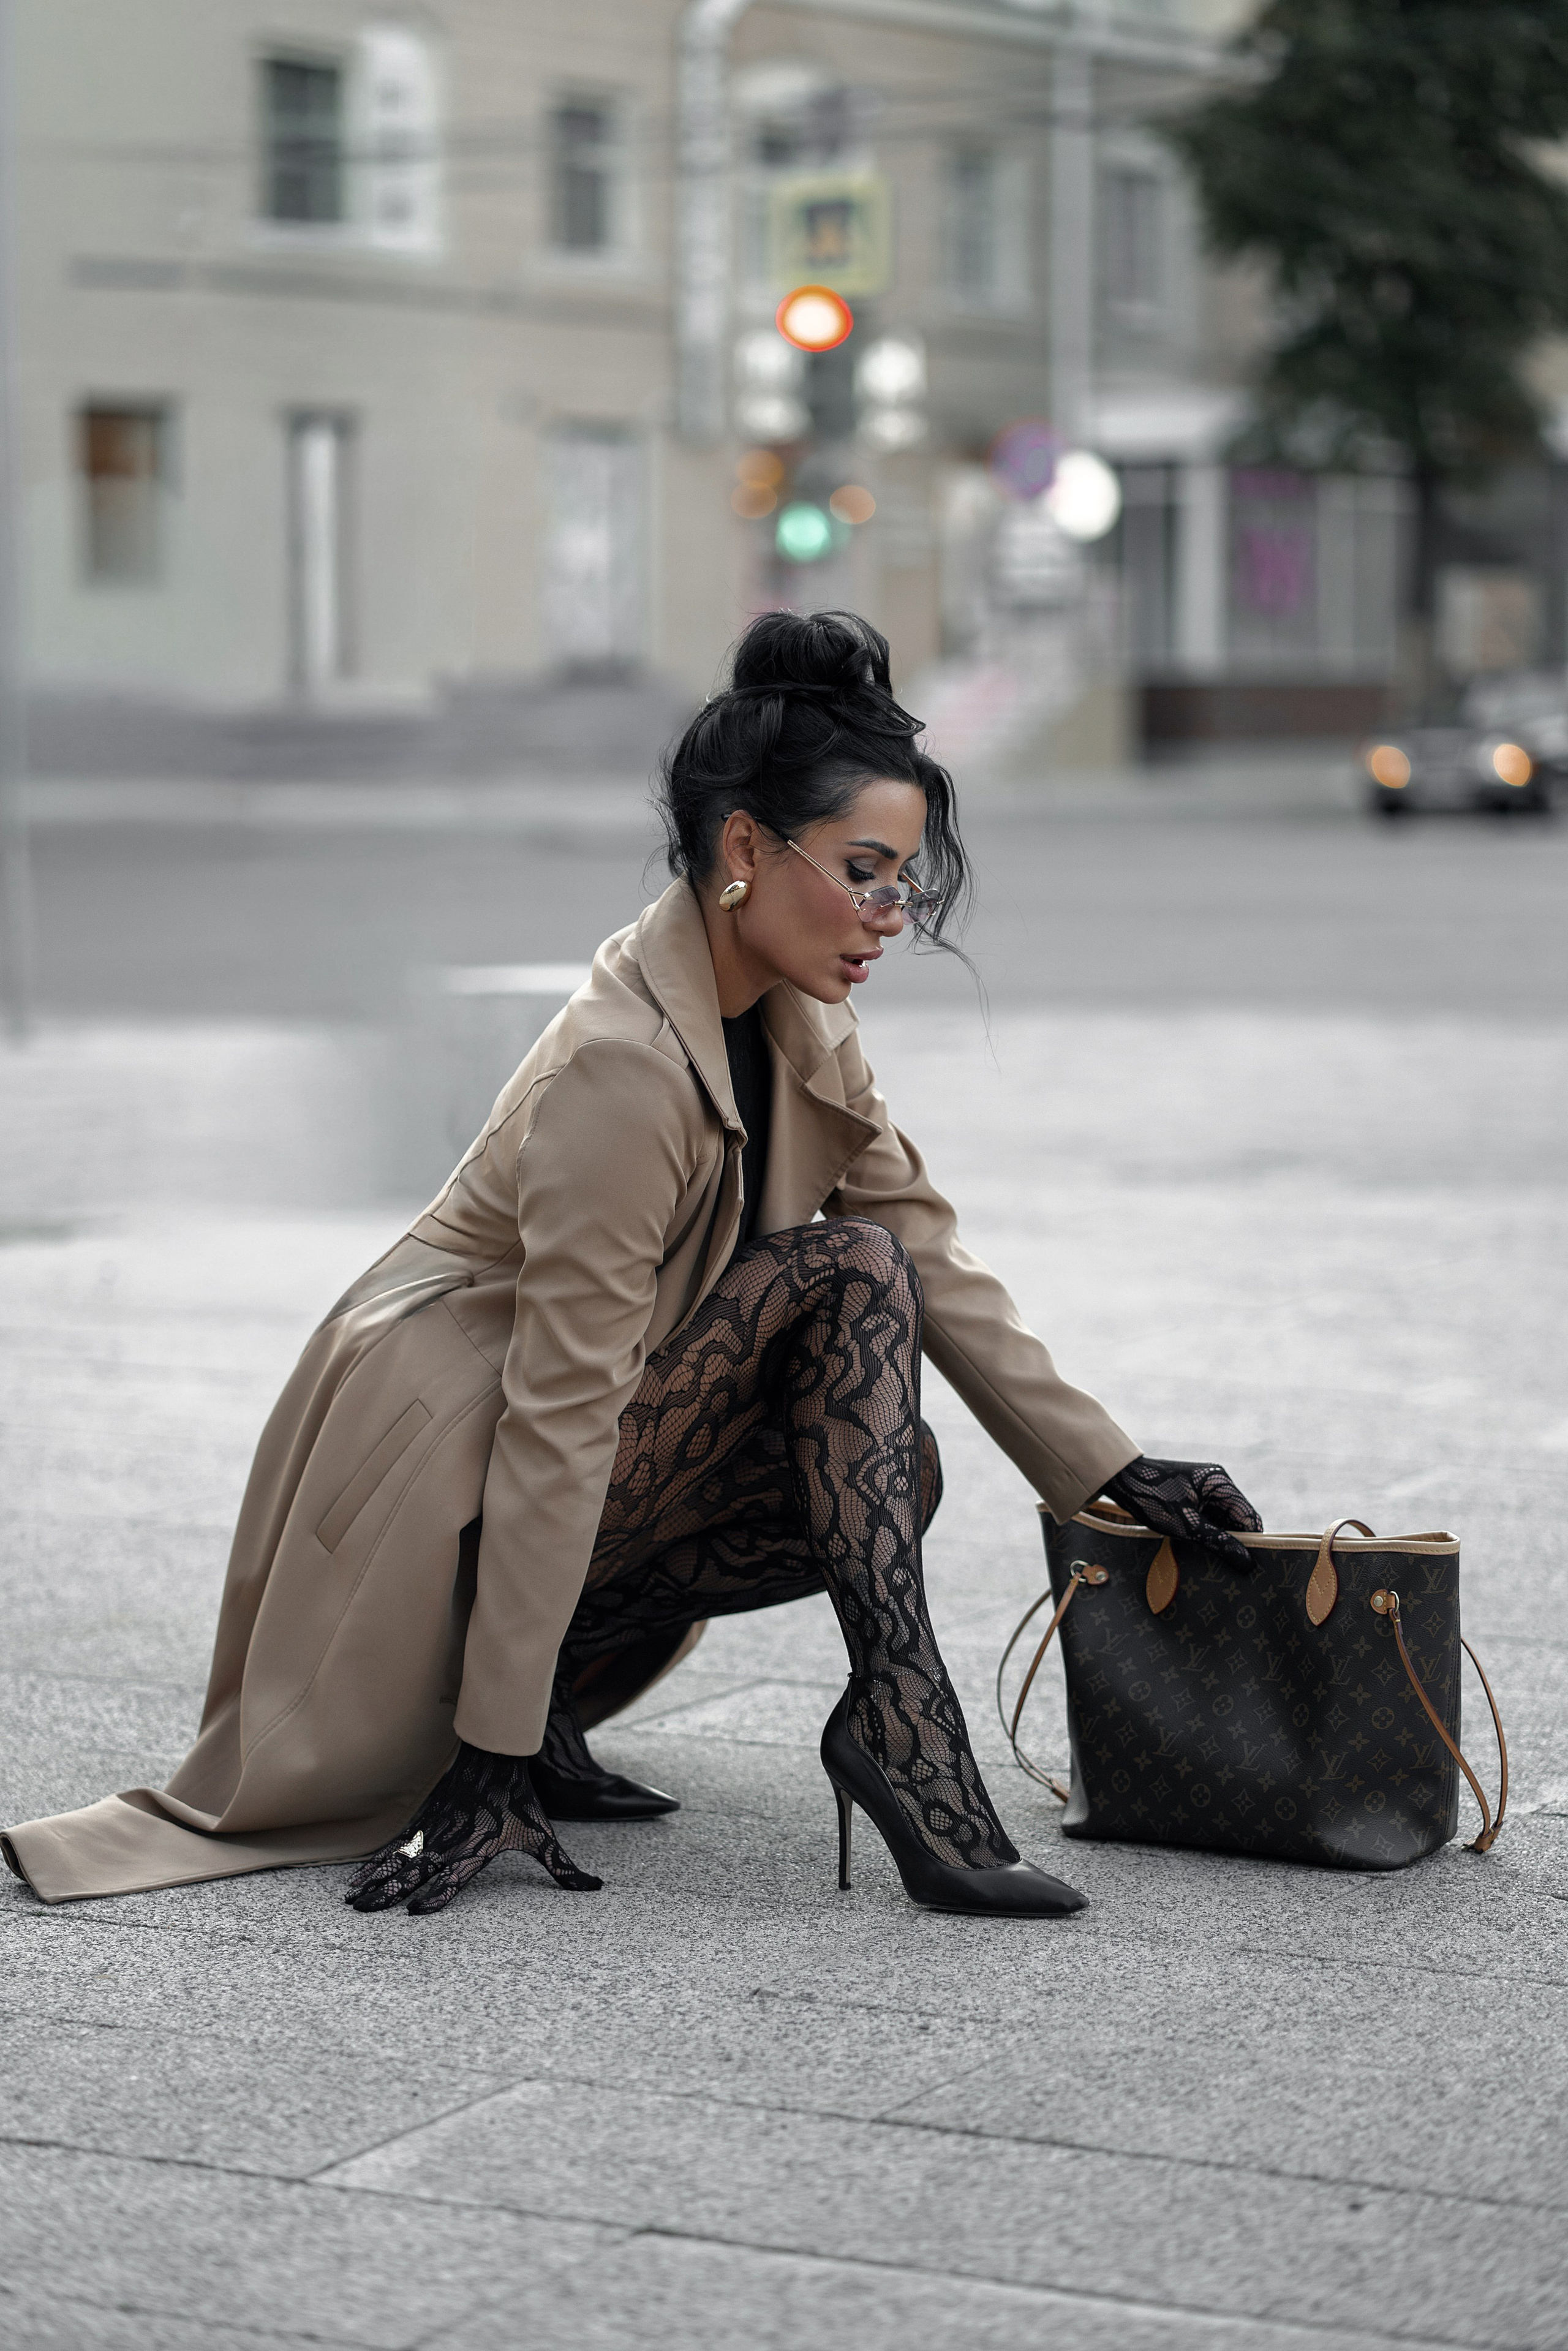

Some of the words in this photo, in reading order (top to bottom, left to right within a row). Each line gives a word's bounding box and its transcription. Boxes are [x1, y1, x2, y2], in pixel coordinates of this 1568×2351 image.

[1278, 1558, 1302, 1588] LV
[1419, 1564, 1449, 1594] LV
[1096, 1627, 1131, 1656] LV
[1181, 1643, 1215, 1672] LV
[1261, 1651, 1286, 1681] LV
[1327, 1655, 1352, 1685] LV
[1419, 1653, 1443, 1683] LV
[1079, 1713, 1101, 1743] LV
[1152, 1726, 1185, 1757] LV
[1235, 1740, 1267, 1771] LV
[1319, 1749, 1349, 1779] LV
[1409, 1739, 1437, 1770] LV
